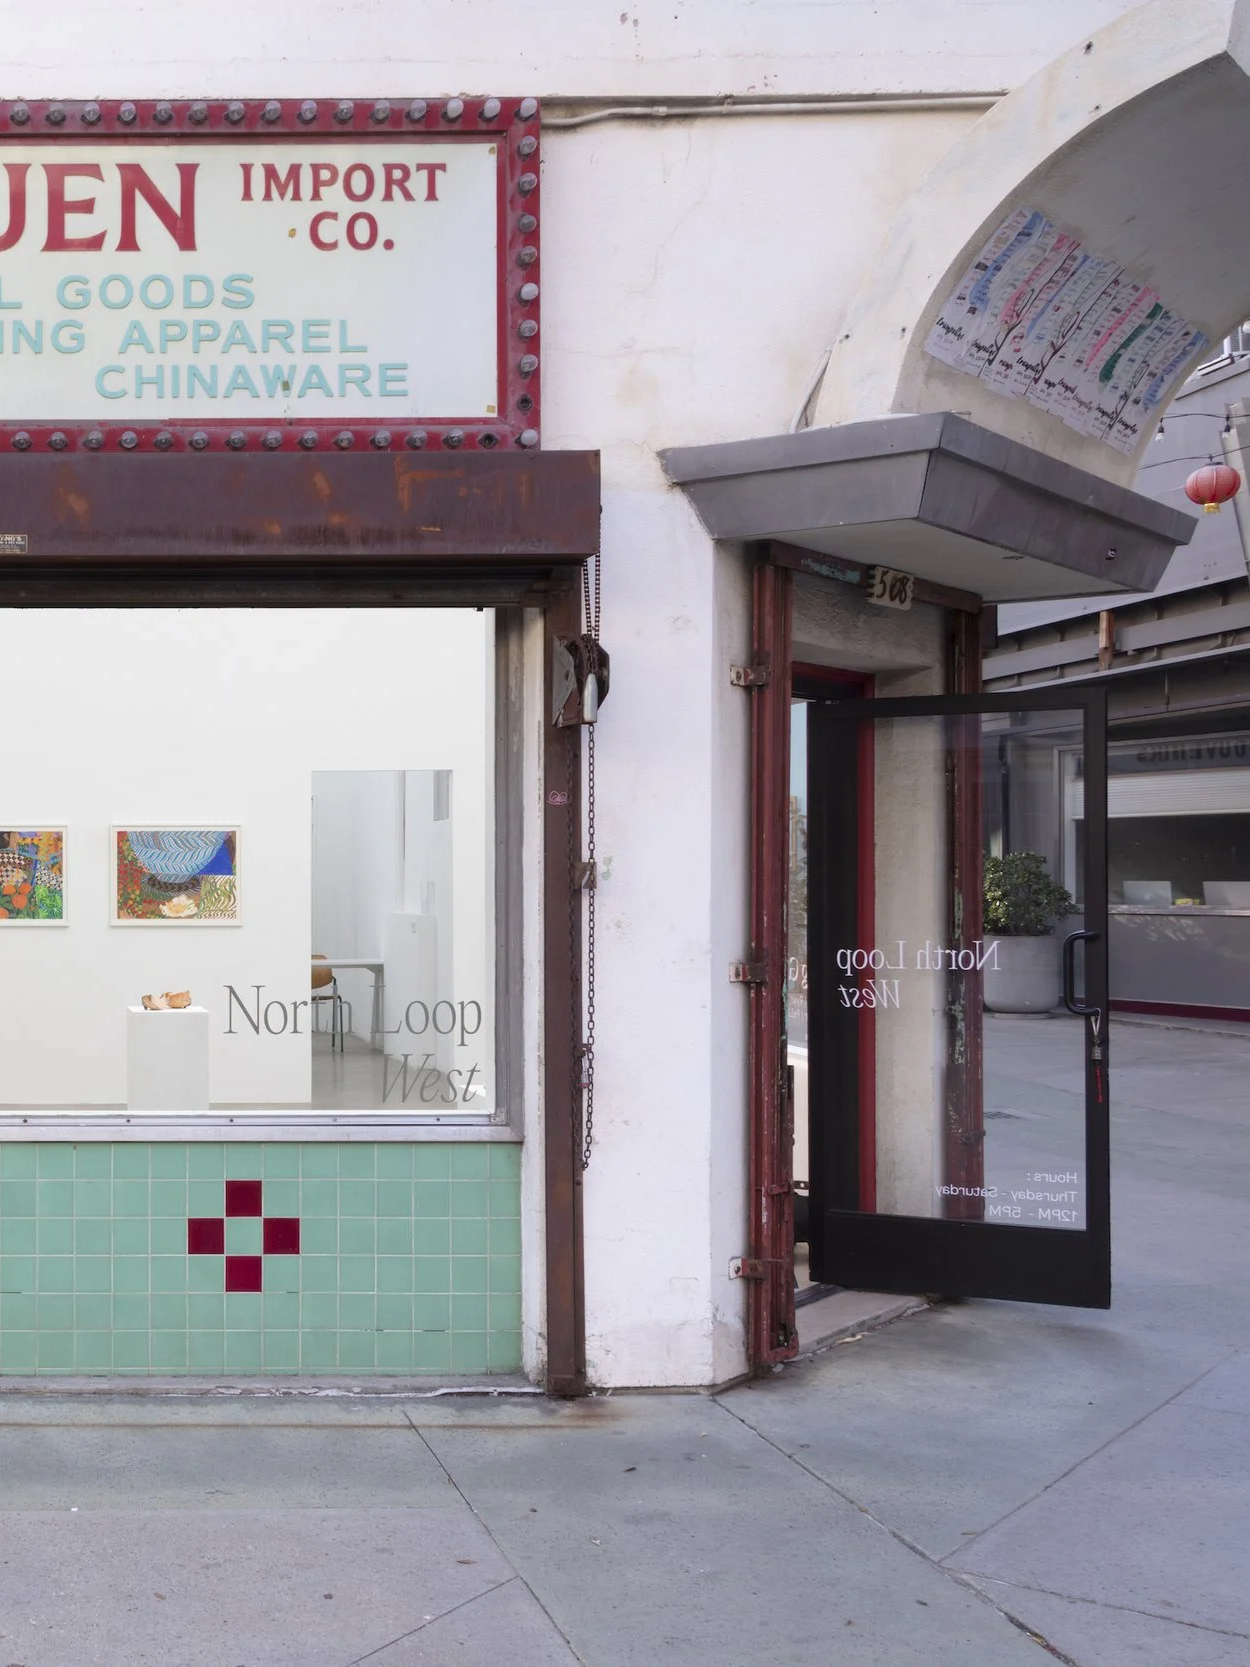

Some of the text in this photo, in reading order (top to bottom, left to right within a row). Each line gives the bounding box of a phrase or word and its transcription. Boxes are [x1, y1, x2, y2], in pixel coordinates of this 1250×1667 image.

[240, 163, 447, 202] IMPORT
[309, 212, 395, 251] CO.
[57, 274, 255, 309] GOODS
[119, 319, 368, 354] APPAREL
[95, 363, 410, 399] CHINAWARE
[876, 569, 911, 605] 508
[223, 985, 482, 1047] North Loop
[381, 1053, 482, 1103] West
